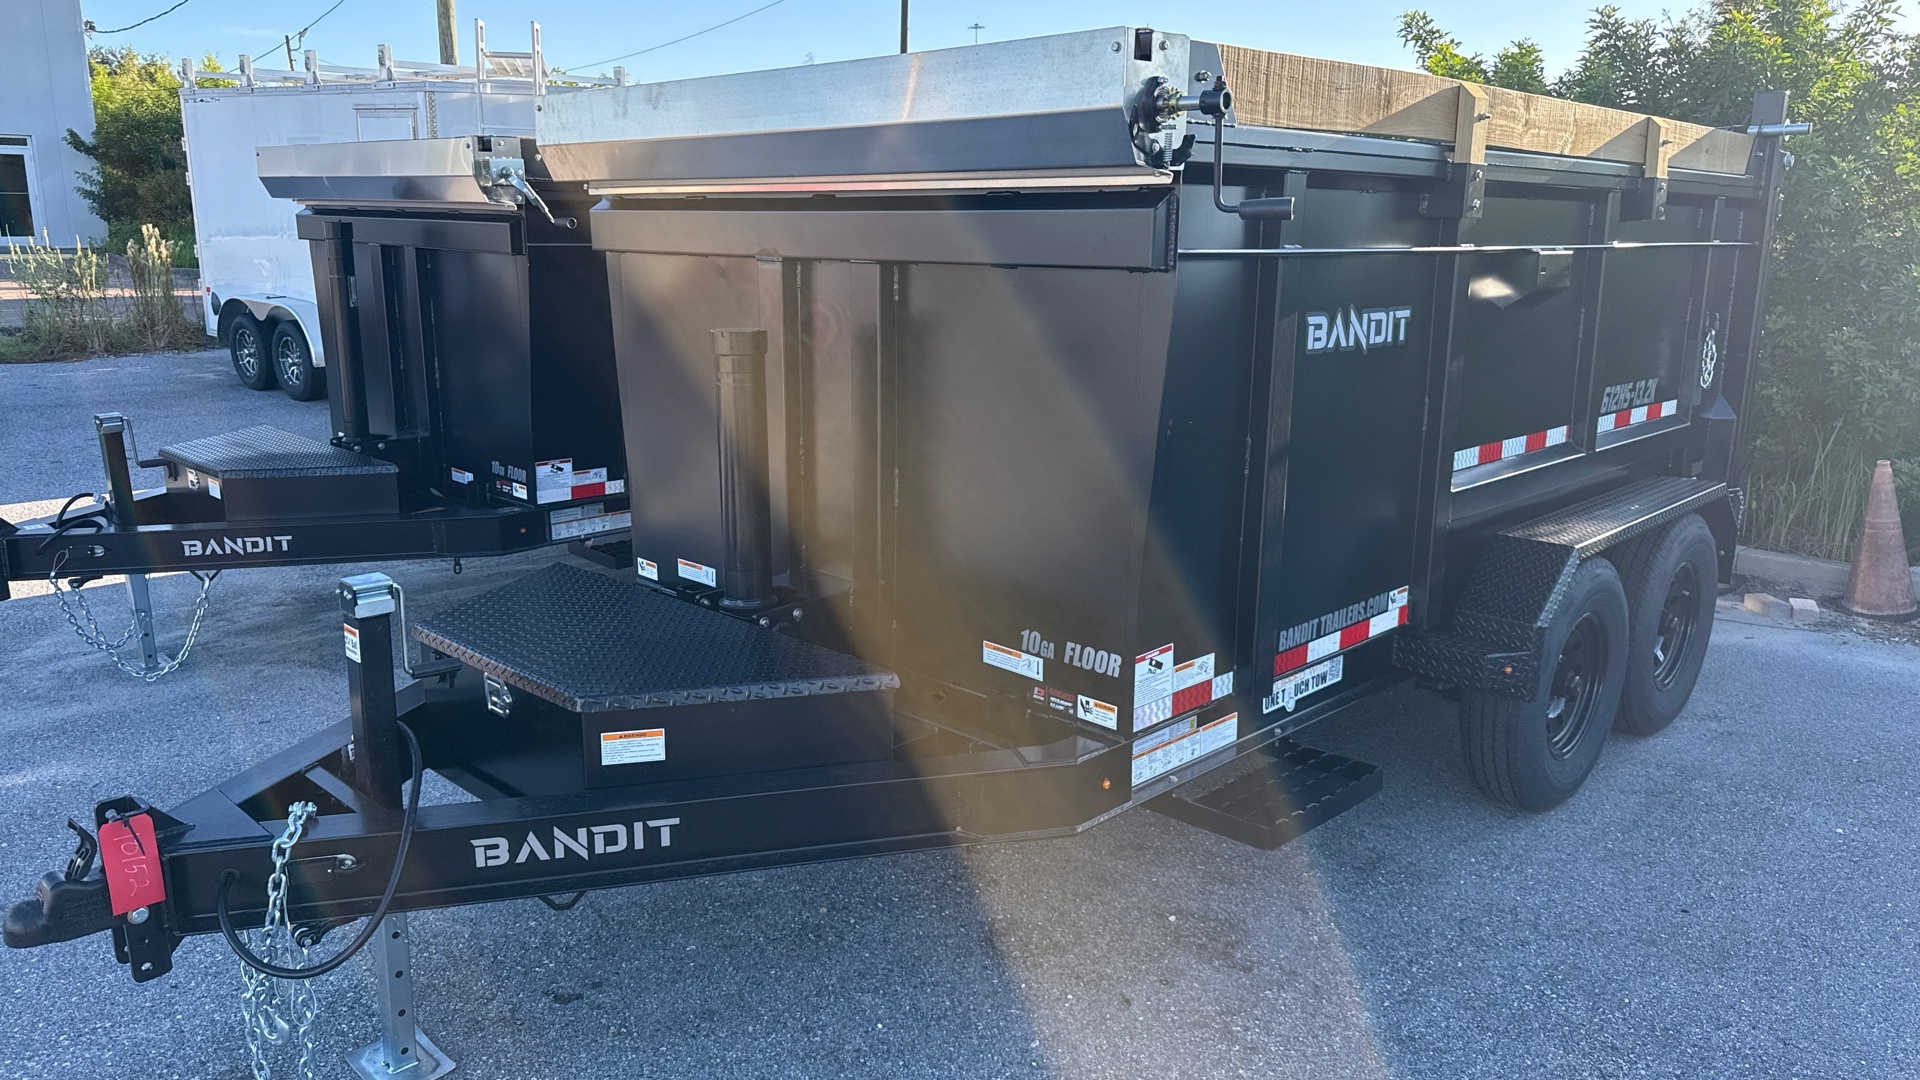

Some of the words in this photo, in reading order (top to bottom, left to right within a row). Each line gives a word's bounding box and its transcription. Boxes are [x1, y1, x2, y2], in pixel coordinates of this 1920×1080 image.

[1306, 307, 1411, 351] BANDIT
[507, 464, 527, 484] FLOOR
[181, 535, 293, 557] BANDIT
[1278, 617, 1319, 652] BANDIT
[1320, 591, 1389, 636] TRAILERS.COM
[1020, 629, 1055, 660] 10GA
[1063, 641, 1123, 678] FLOOR
[1310, 670, 1328, 690] TOW
[469, 817, 681, 868] BANDIT
